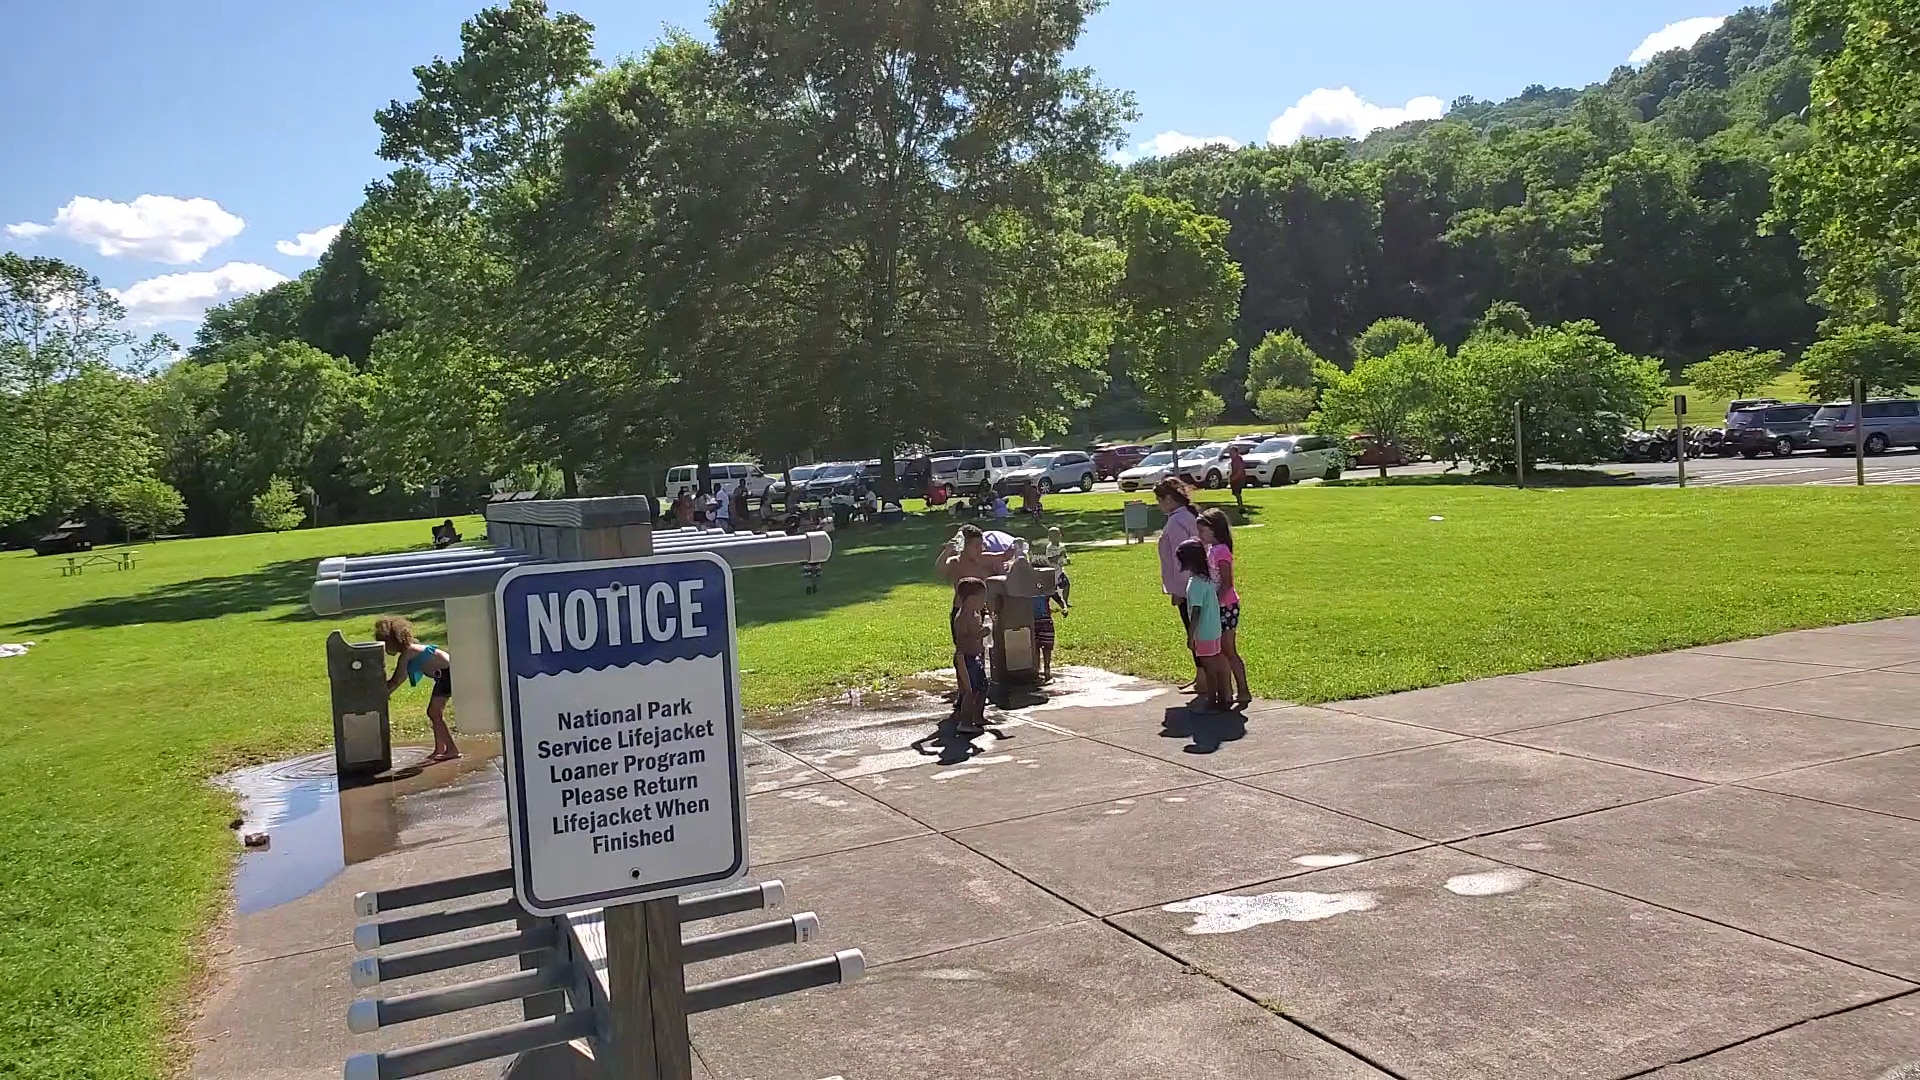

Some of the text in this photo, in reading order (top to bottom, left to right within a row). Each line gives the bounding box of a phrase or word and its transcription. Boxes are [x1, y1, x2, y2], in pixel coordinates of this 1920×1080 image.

[527, 580, 707, 654] NOTICE
[558, 698, 693, 731] National Park
[538, 720, 714, 759] Service Lifejacket
[550, 749, 706, 783] Loaner Program
[561, 775, 699, 808] Please Return
[553, 797, 710, 835] Lifejacket When
[593, 824, 675, 854] Finished
